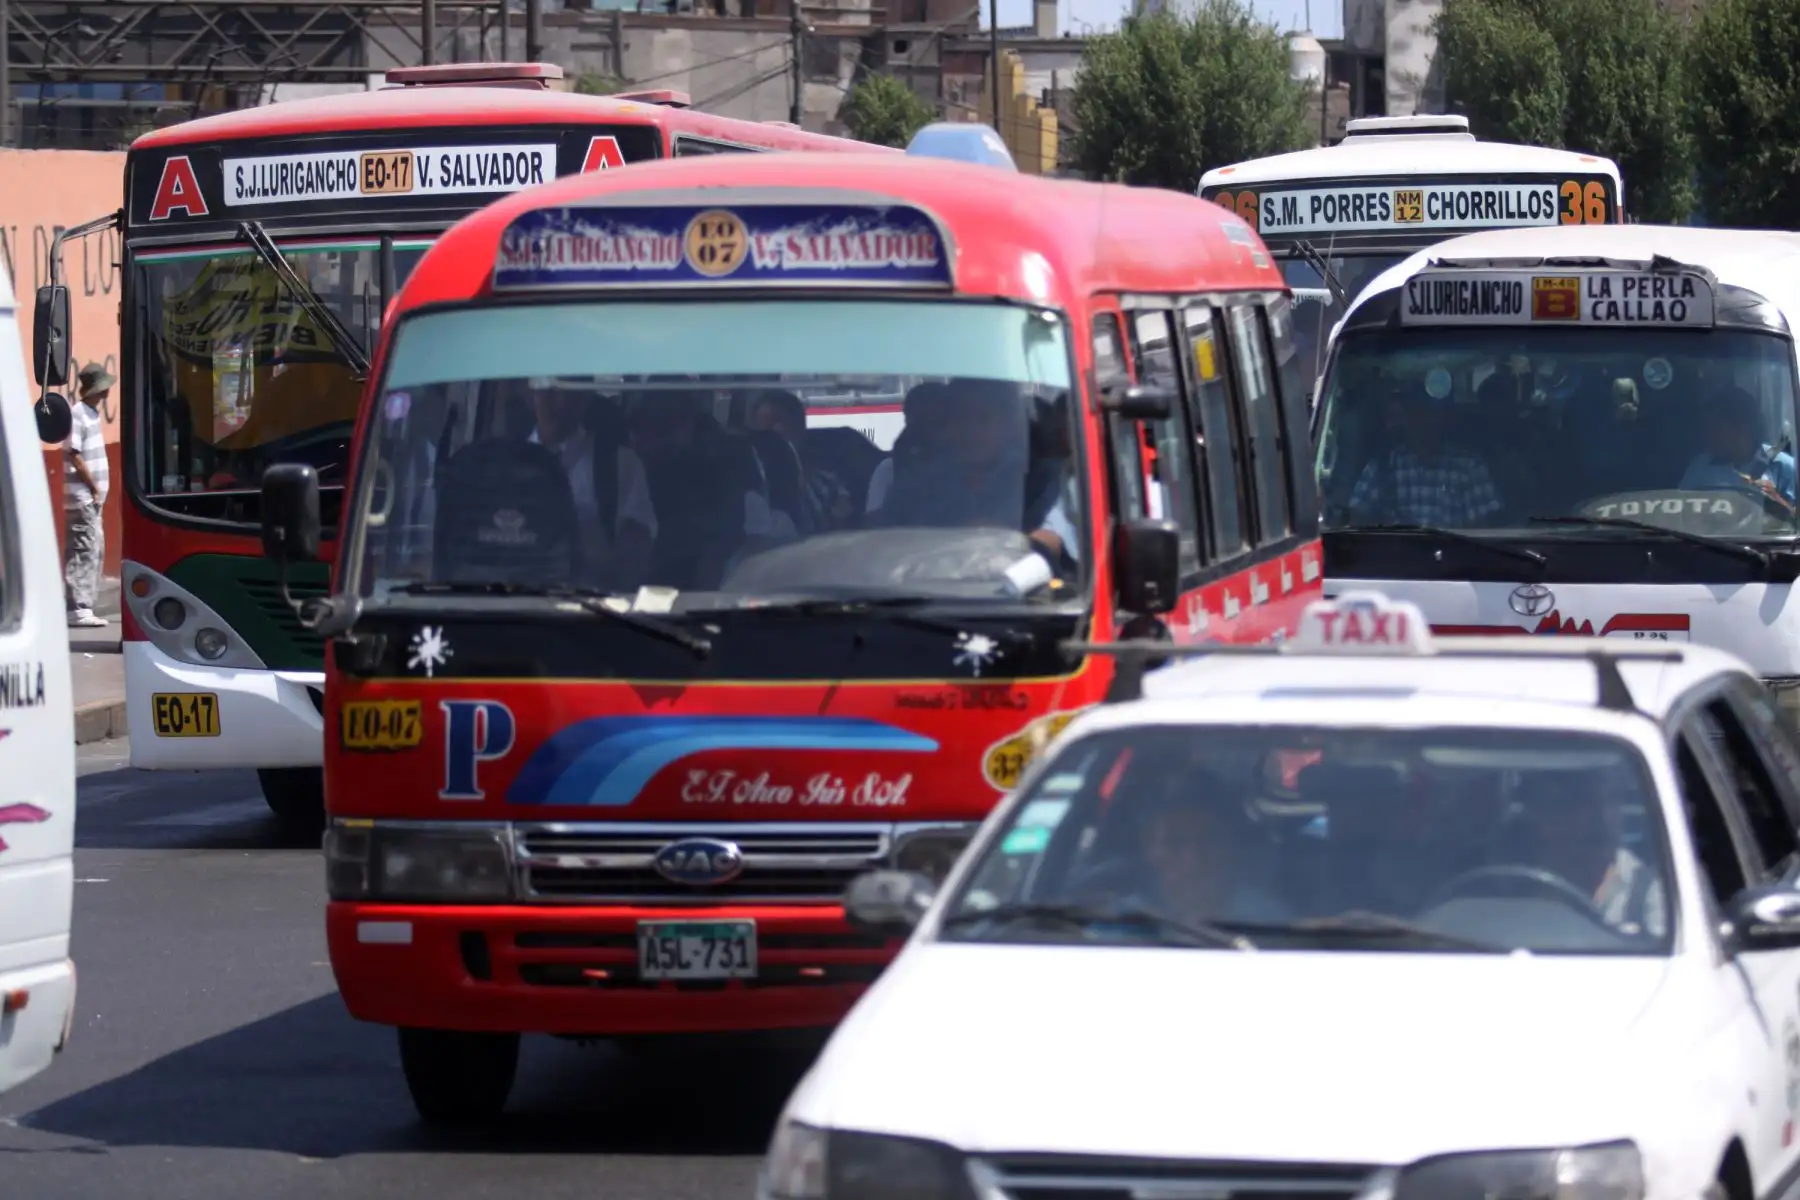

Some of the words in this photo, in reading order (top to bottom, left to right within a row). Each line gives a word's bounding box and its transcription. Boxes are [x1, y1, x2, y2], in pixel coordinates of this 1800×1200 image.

[364, 156, 409, 189] EO-17
[417, 155, 433, 188] V.
[440, 151, 543, 187] SALVADOR
[149, 156, 209, 220] A
[1396, 190, 1421, 205] NM
[1560, 180, 1606, 225] 36
[1263, 197, 1303, 227] S.M.
[1310, 192, 1390, 224] PORRES
[1397, 206, 1421, 220] 12
[1427, 190, 1554, 221] CHORRILLOS
[698, 244, 736, 265] 07
[786, 232, 936, 263] SALVADOR
[1587, 277, 1611, 298] LA
[1623, 277, 1695, 299] PERLA
[1534, 290, 1575, 318] B
[1591, 300, 1687, 322] CALLAO
[1596, 499, 1734, 518] TOYOTA
[1315, 610, 1407, 645] TAXI
[156, 696, 213, 733] EO-17
[438, 699, 516, 800] P
